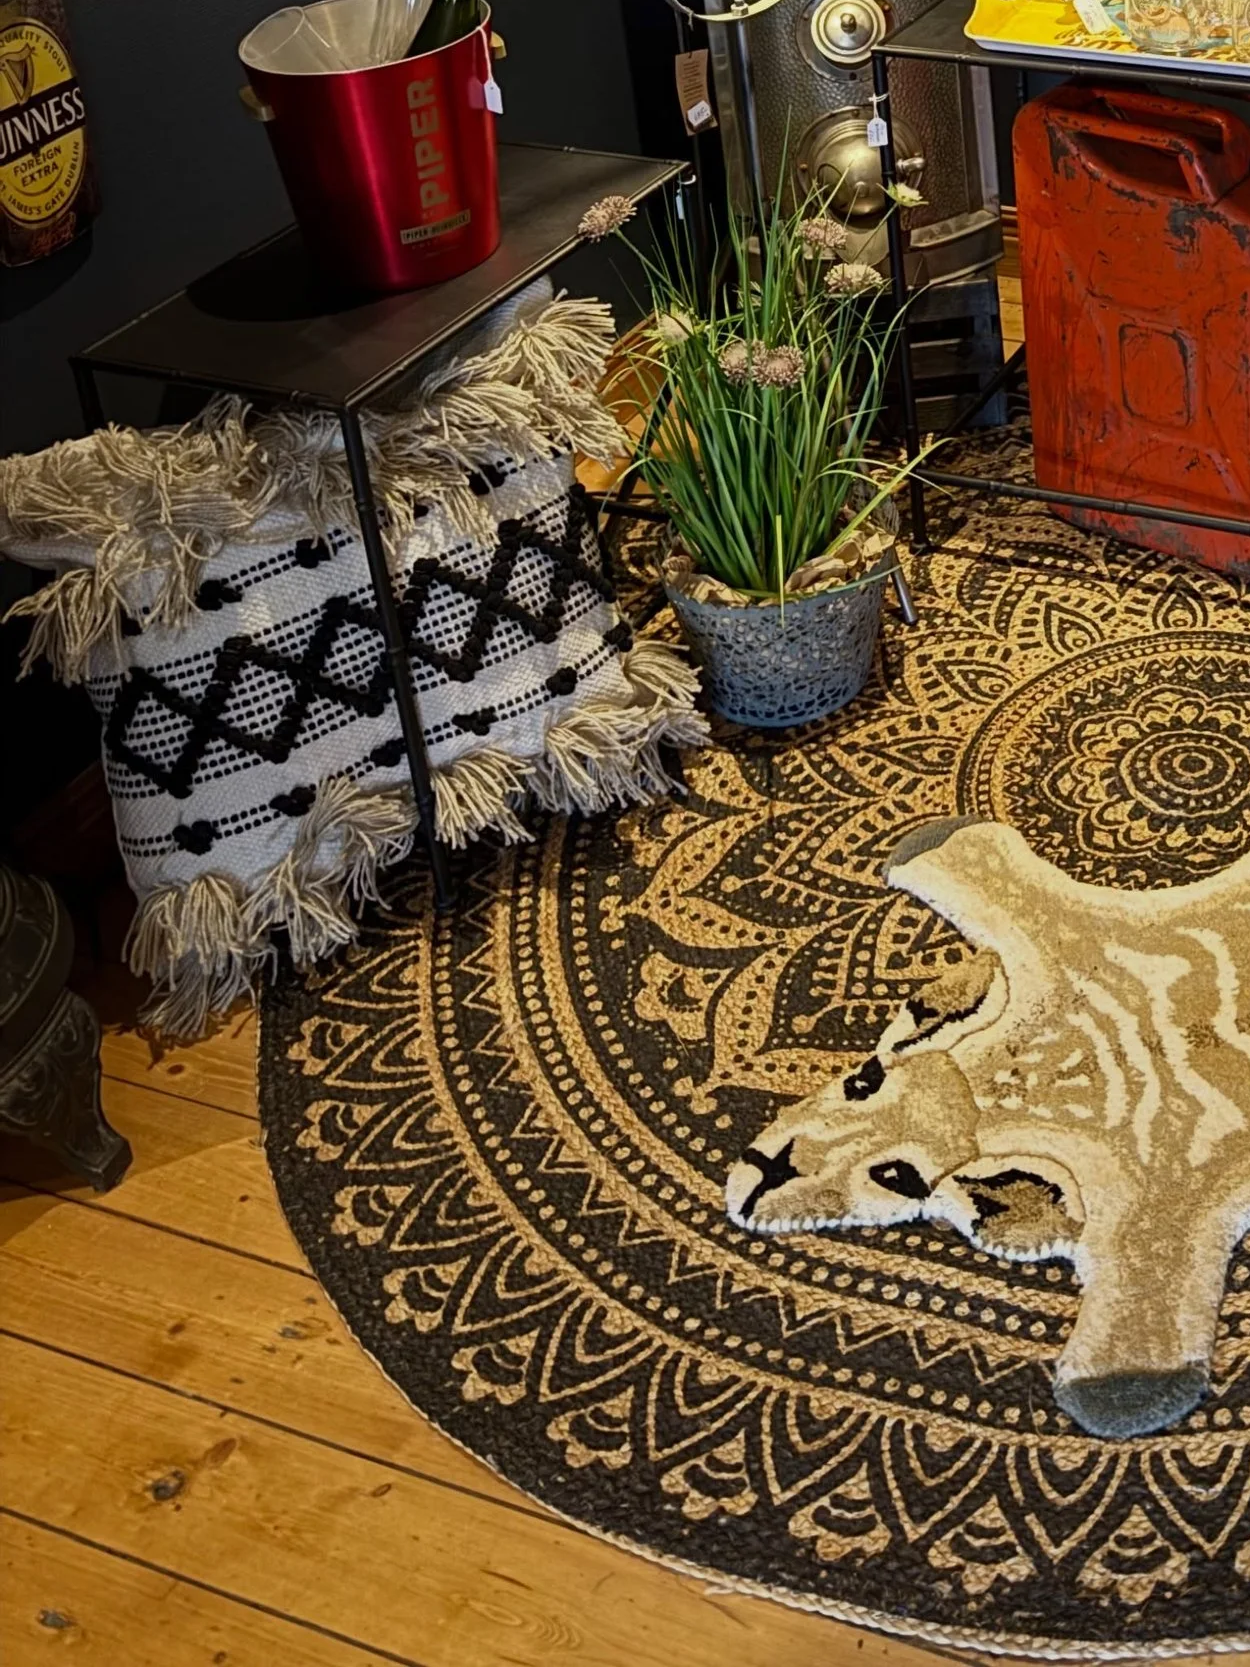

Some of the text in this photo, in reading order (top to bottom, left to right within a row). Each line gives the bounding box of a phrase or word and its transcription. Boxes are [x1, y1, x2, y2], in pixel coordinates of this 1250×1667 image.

[43, 40, 67, 74] STOUT
[405, 76, 449, 210] PIPER
[13, 144, 63, 177] FOREIGN
[21, 162, 60, 188] EXTRA
[44, 189, 66, 212] GATE
[64, 140, 80, 185] DUBLIN
